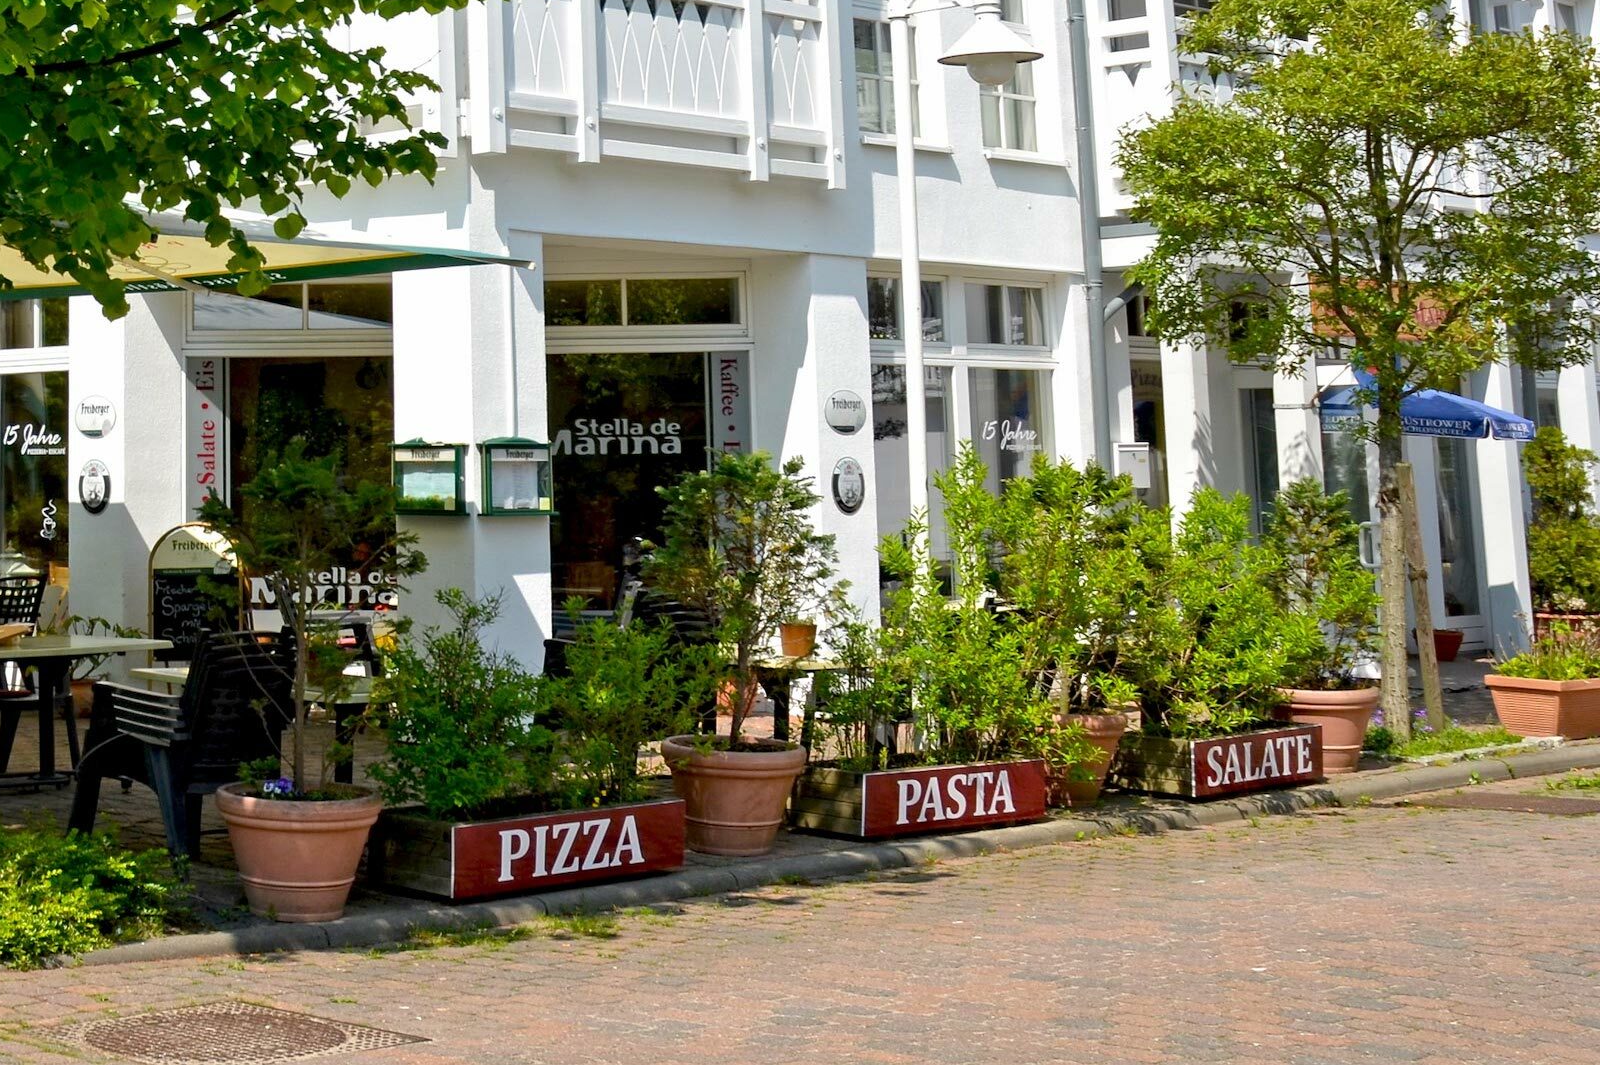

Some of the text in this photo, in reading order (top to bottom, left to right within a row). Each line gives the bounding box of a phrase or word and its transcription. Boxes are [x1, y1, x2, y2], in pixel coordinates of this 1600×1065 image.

[719, 358, 740, 417] Kaffee
[3, 423, 62, 455] 15 Jahre
[195, 360, 216, 485] Salate Eis
[574, 418, 682, 436] Stella de
[982, 419, 1038, 450] 15 Jahre
[294, 566, 362, 585] tella
[1207, 734, 1313, 787] SALATE
[896, 769, 1016, 825] PASTA
[498, 814, 645, 882] PIZZA
